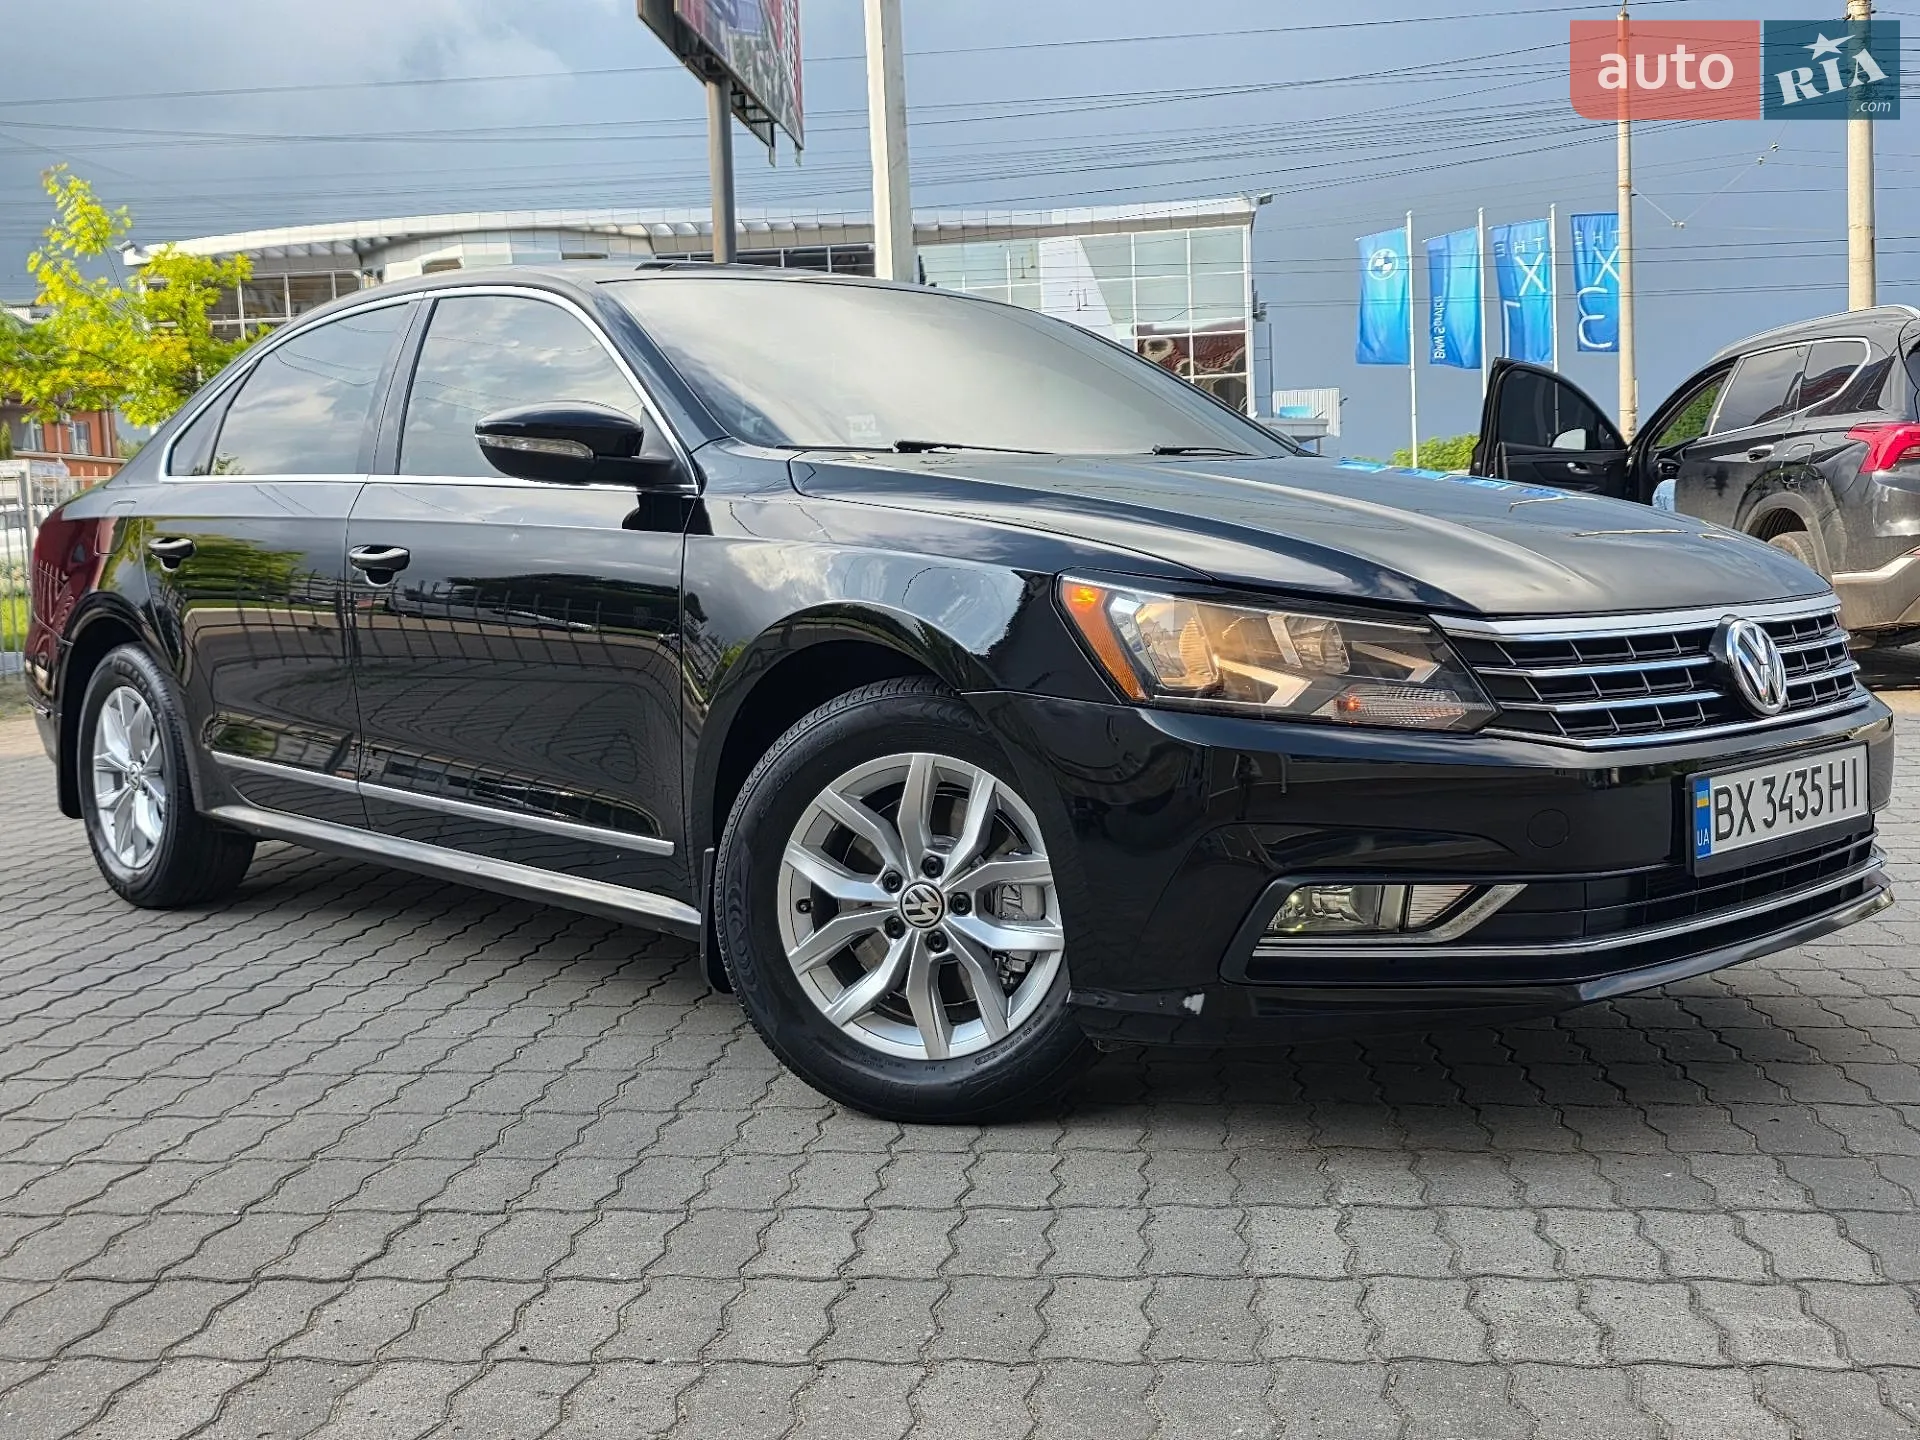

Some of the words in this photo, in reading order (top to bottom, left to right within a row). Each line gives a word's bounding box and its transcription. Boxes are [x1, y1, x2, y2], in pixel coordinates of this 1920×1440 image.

[1714, 778, 1755, 841] BX
[1762, 763, 1824, 829] 3435
[1828, 756, 1858, 813] HI
[1696, 828, 1710, 847] UA
